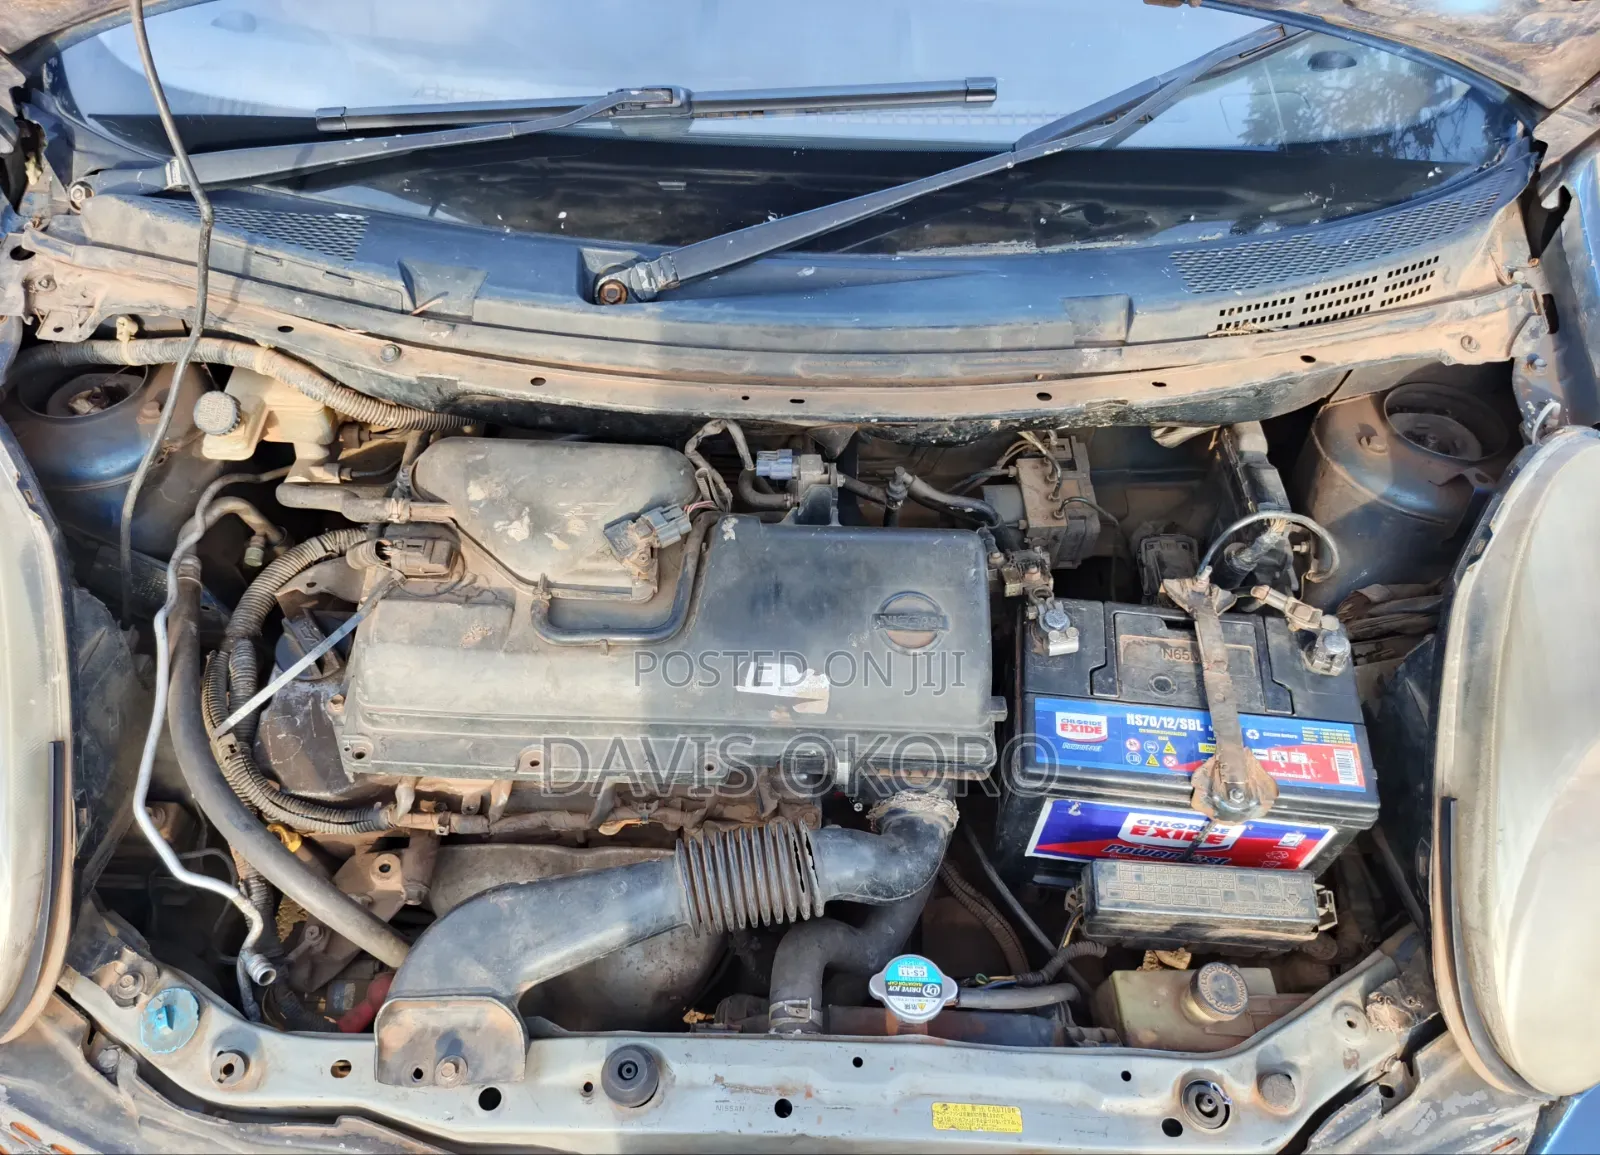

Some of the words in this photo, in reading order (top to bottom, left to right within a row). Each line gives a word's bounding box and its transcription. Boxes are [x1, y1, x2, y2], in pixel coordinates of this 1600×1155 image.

[1061, 718, 1102, 726] CHLORIDE
[1060, 723, 1103, 735] EXIDE
[987, 1106, 1016, 1114] CAUTION
